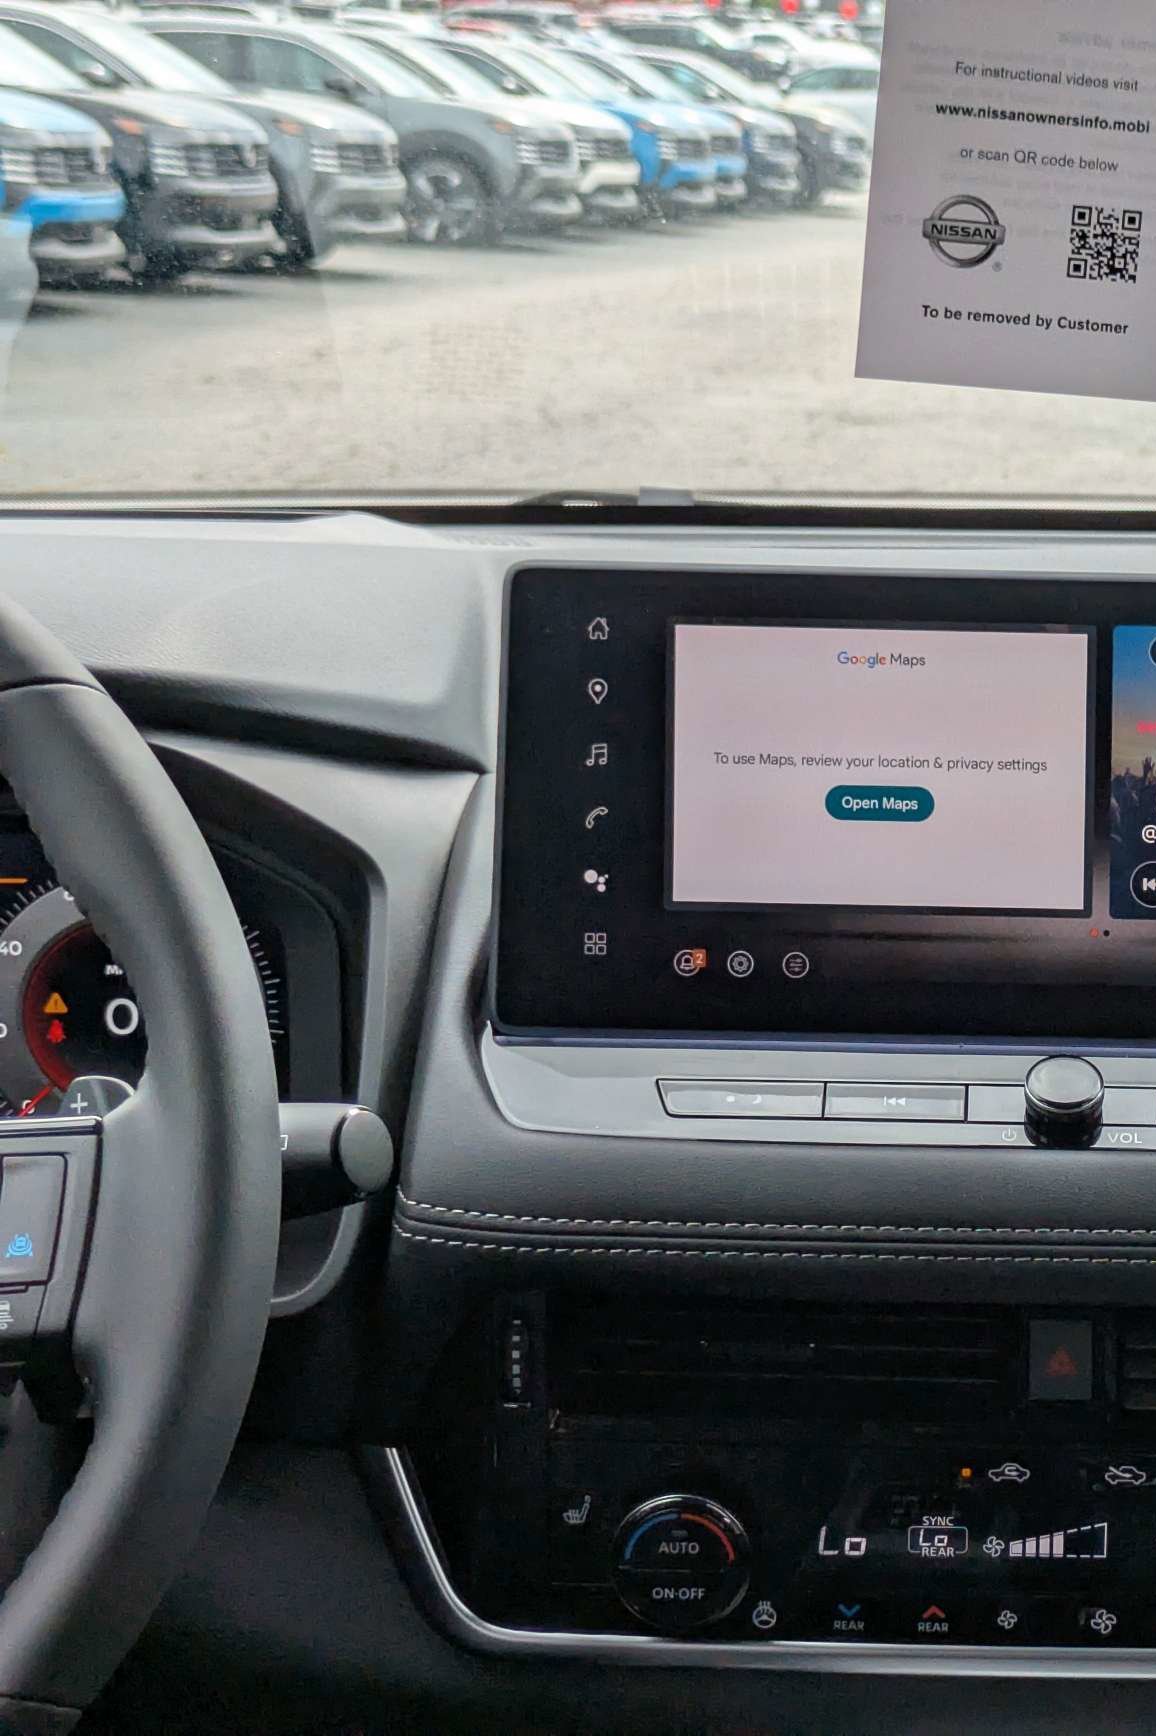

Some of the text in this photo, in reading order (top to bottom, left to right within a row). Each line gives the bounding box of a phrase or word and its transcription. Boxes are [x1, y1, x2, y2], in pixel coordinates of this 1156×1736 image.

[955, 61, 1139, 92] For instructional videos visit
[935, 104, 1150, 134] www.nissanownersinfo.mobi
[960, 148, 1119, 172] or scan QR code below
[930, 223, 998, 240] NISSAN
[922, 305, 1129, 335] To be removed by Customer
[837, 651, 927, 669] Google Maps
[714, 752, 1048, 774] To use Maps, review your location & privacy settings
[841, 796, 919, 812] Open Maps
[1108, 1132, 1142, 1144] VOL
[922, 1515, 955, 1527] SYNC
[658, 1541, 700, 1555] AUTO
[921, 1547, 955, 1558] REAR
[833, 1619, 865, 1631] REAR
[917, 1621, 949, 1632] REAR
